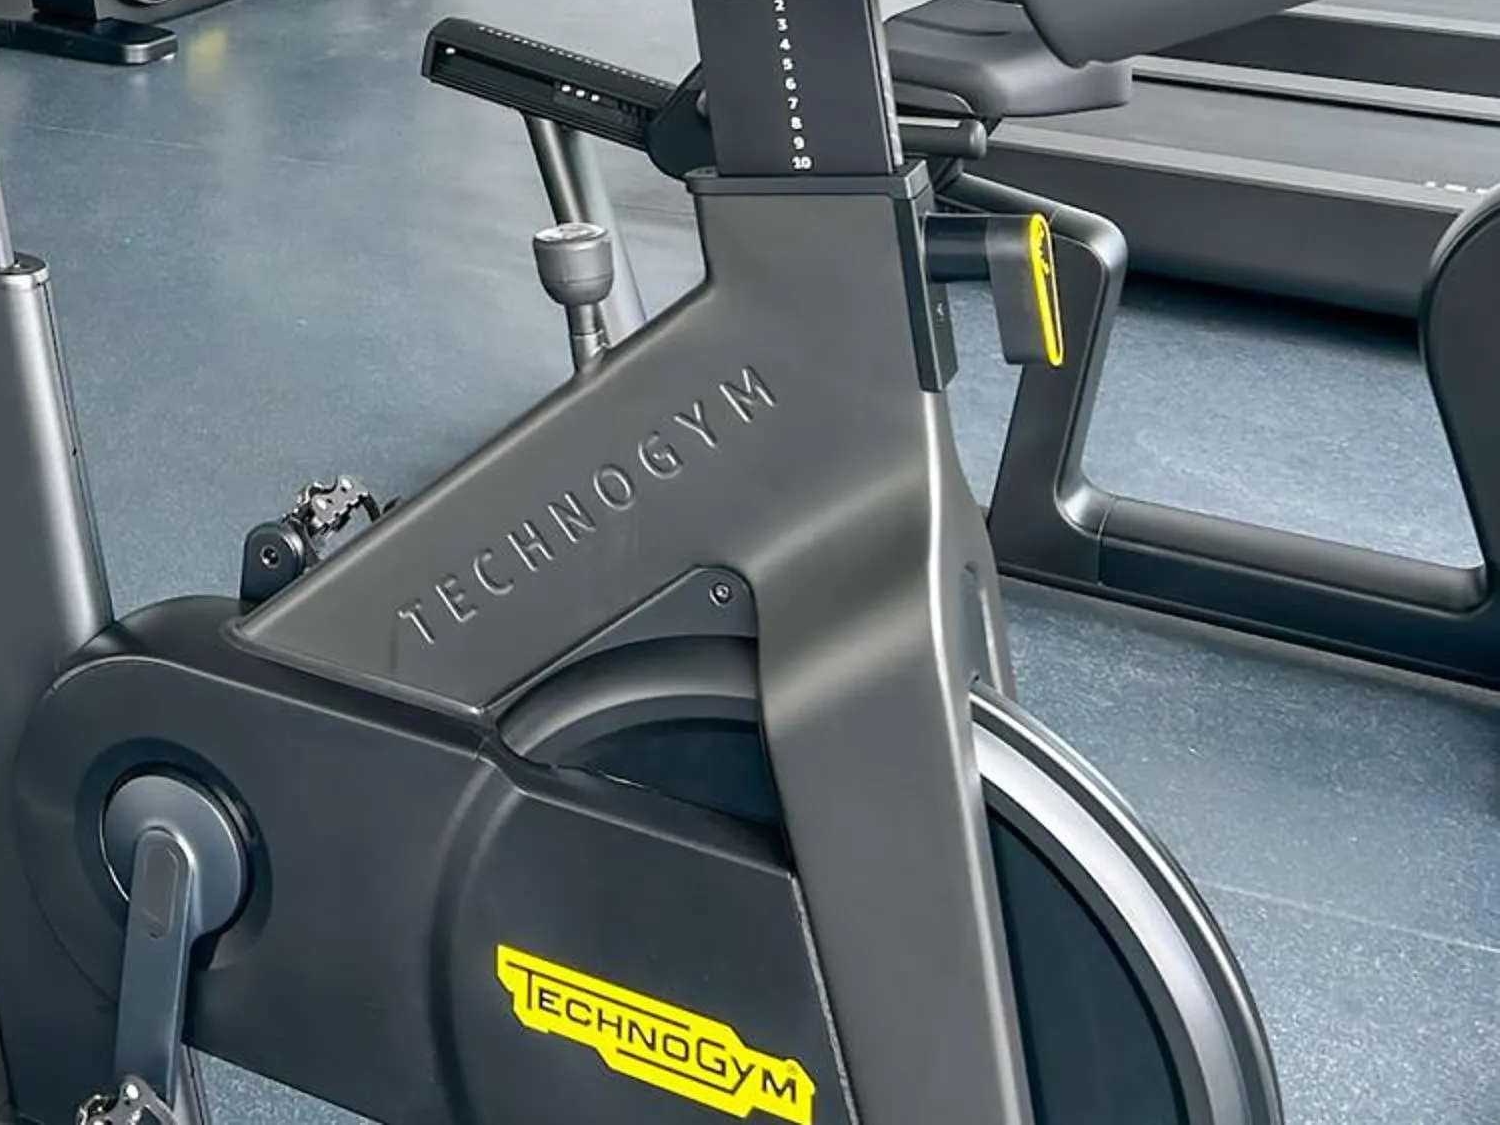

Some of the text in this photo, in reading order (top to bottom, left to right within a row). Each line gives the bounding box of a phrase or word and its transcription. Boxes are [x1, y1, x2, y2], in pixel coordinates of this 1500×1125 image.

[777, 18, 788, 31] 3
[779, 38, 791, 51] 4
[782, 57, 793, 71] 5
[785, 77, 797, 91] 6
[787, 96, 799, 110] 7
[790, 116, 803, 130] 8
[793, 136, 805, 150] 9
[792, 156, 812, 170] 10
[397, 363, 778, 646] TECHNOGYM
